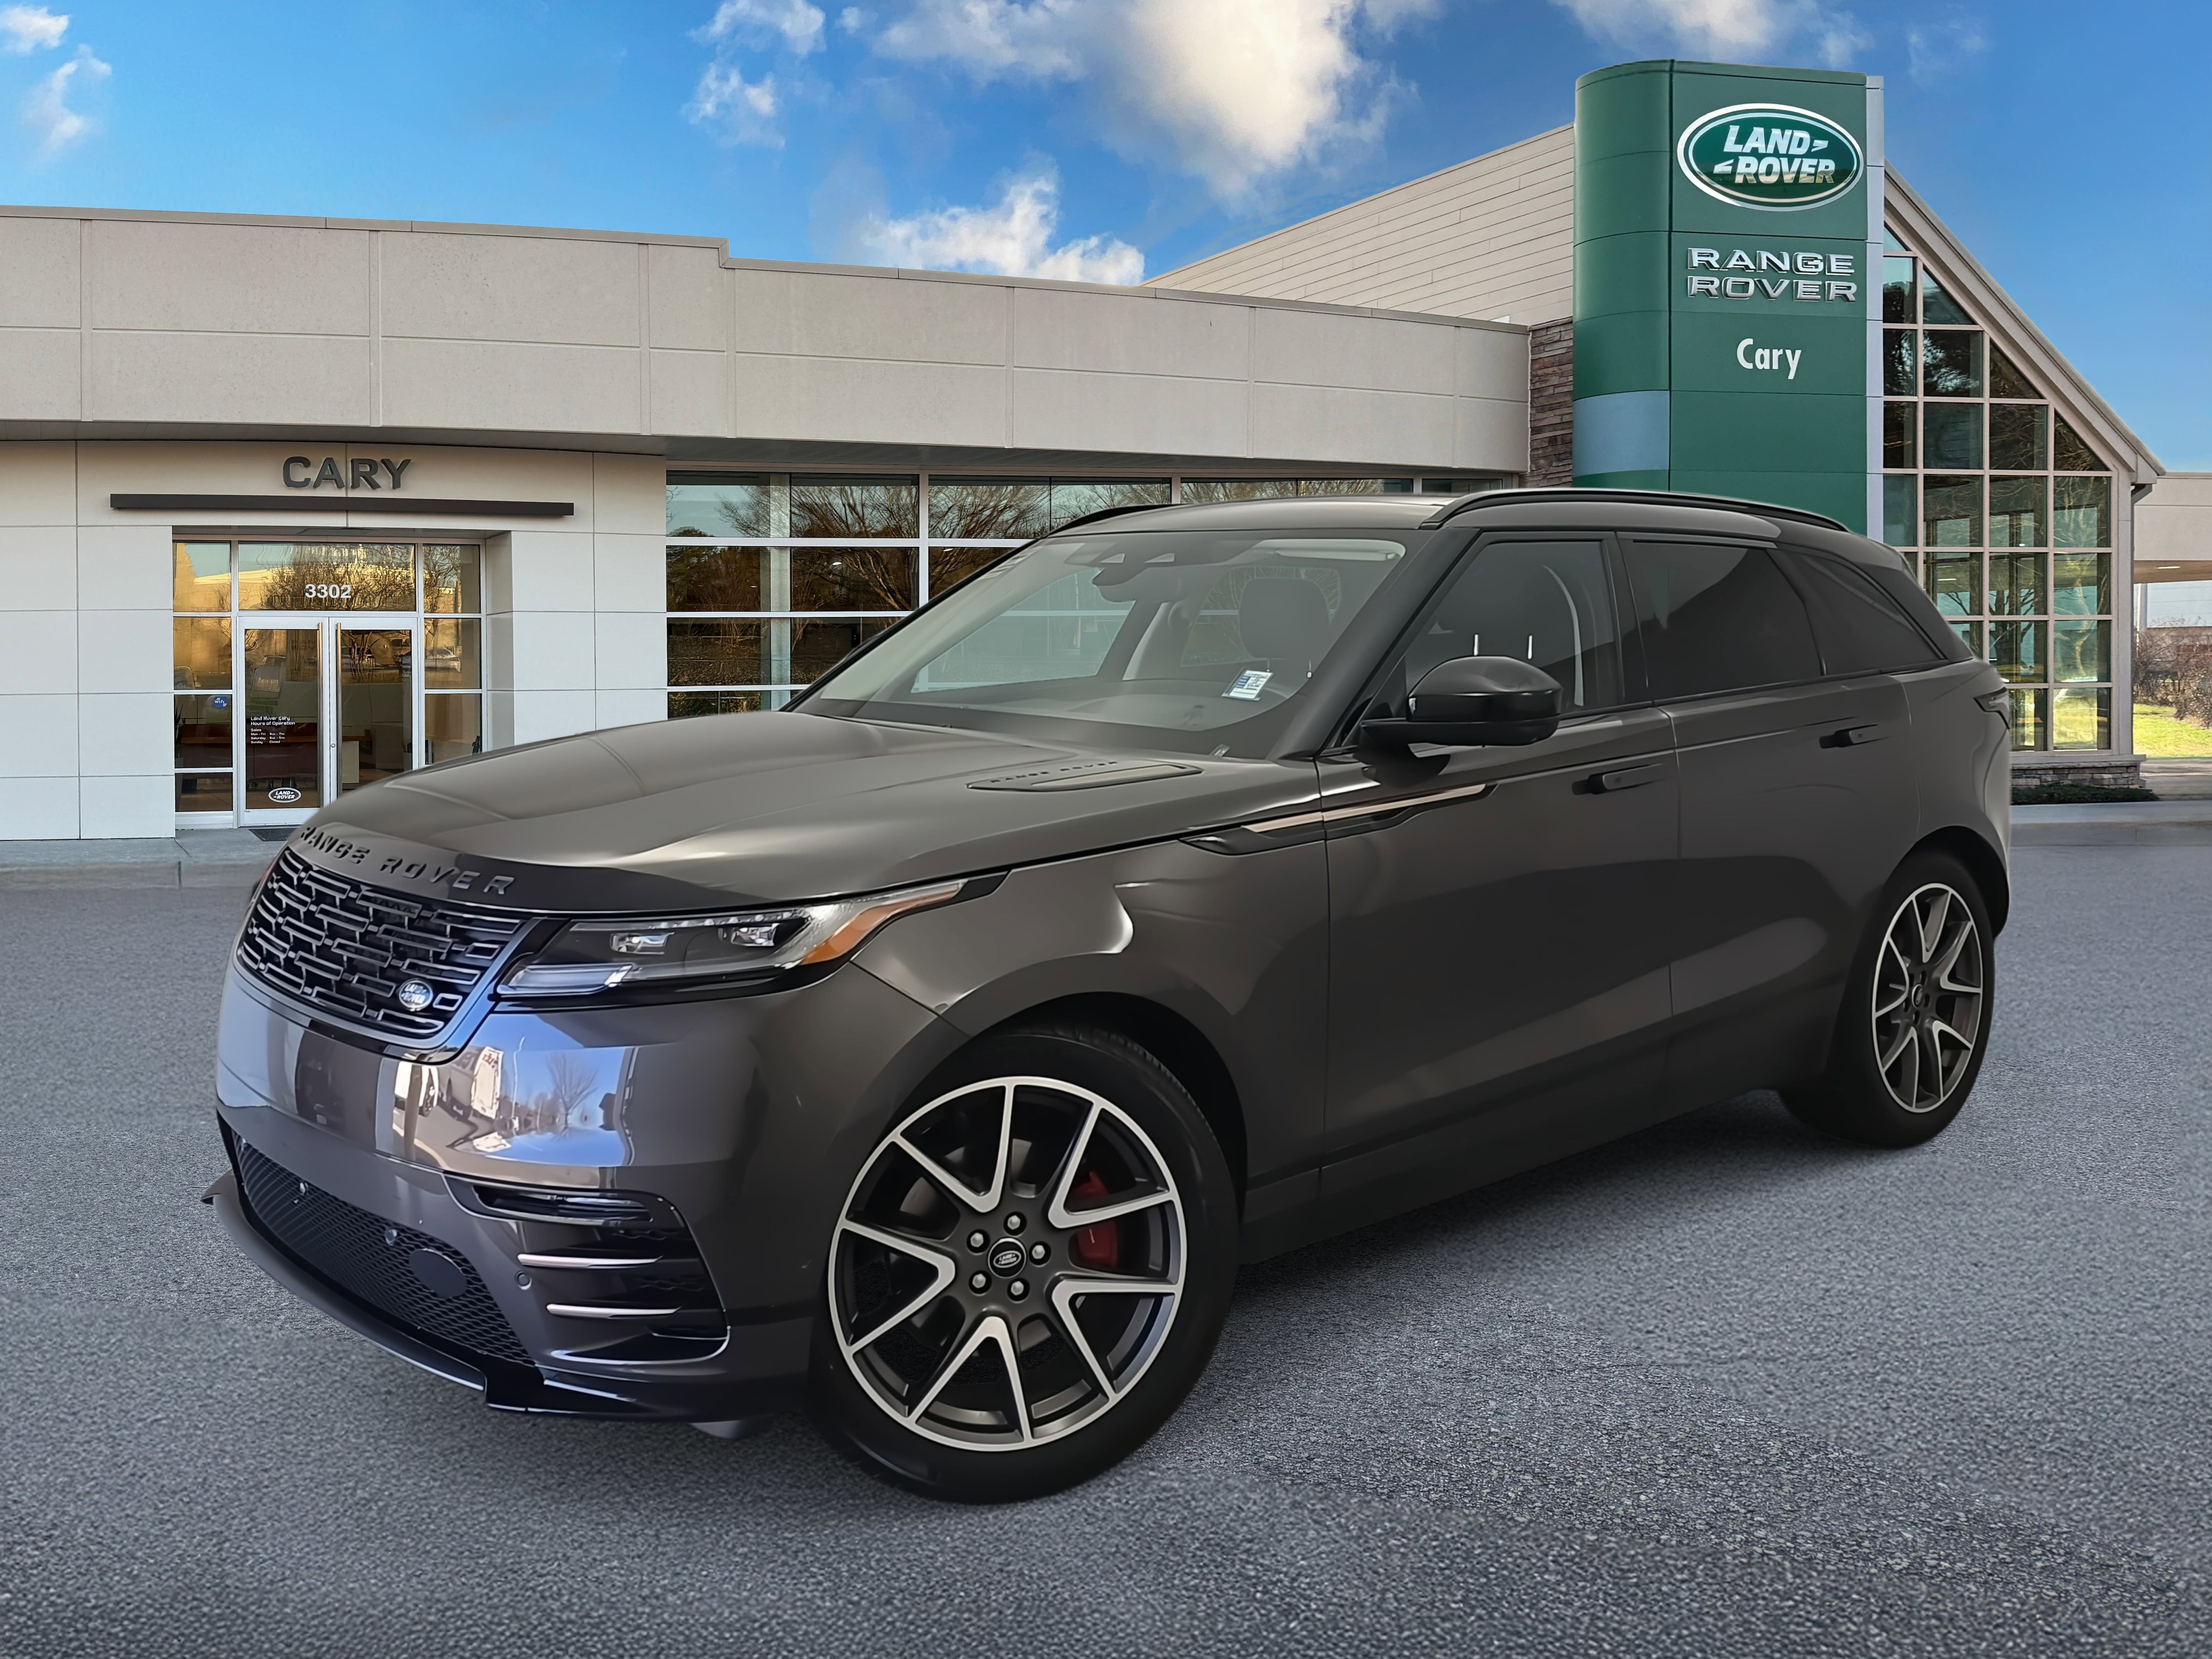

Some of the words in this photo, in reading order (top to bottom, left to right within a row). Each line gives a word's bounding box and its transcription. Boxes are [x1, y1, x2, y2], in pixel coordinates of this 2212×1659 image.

[1723, 125, 1811, 155] LAND
[1735, 156, 1835, 184] ROVER
[1688, 248, 1855, 275] RANGE
[1688, 276, 1857, 302] ROVER
[1736, 338, 1802, 380] Cary
[283, 456, 412, 489] CARY
[305, 584, 351, 599] 3302
[301, 827, 371, 864] RANGE
[380, 858, 515, 895] ROVER
